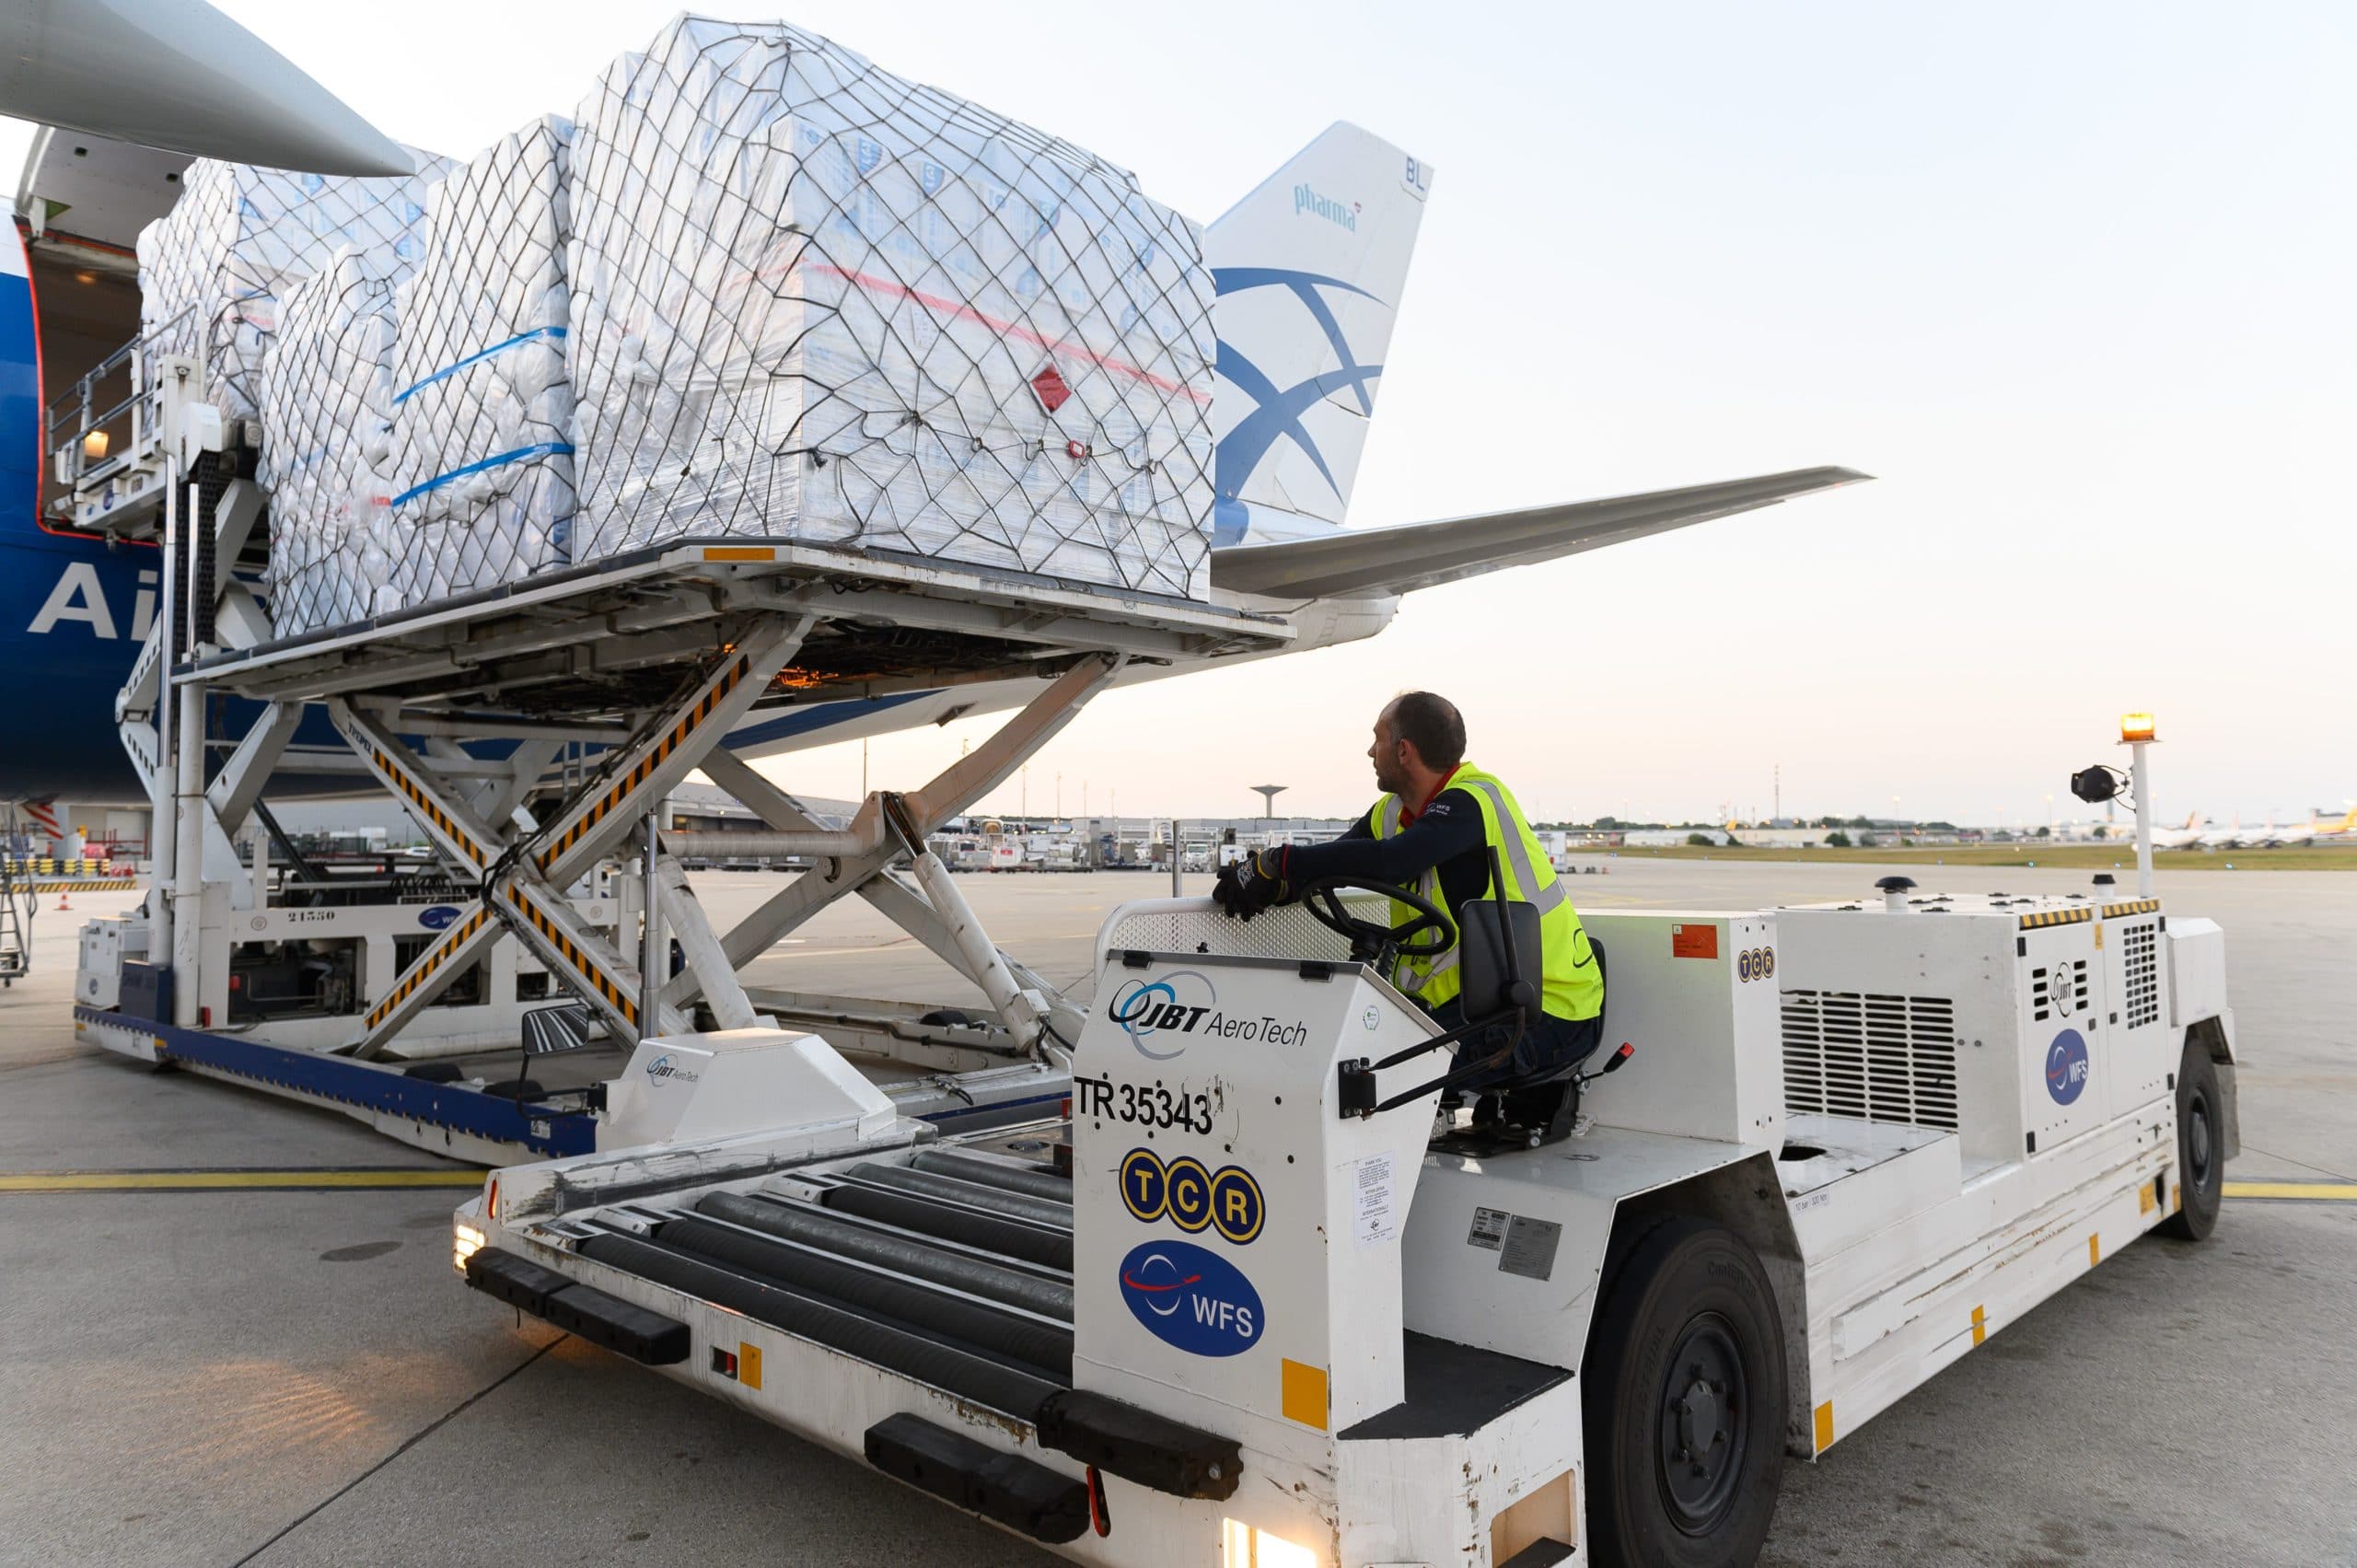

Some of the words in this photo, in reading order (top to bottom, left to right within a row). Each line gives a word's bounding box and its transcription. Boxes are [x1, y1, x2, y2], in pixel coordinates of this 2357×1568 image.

[1407, 155, 1425, 192] BL
[1295, 182, 1356, 233] pharma
[1742, 956, 1772, 974] TCR
[2060, 982, 2072, 1001] JBT
[1138, 1003, 1212, 1033] JBT
[654, 1065, 676, 1077] JBT
[2069, 1059, 2088, 1084] WFS
[1134, 1168, 1248, 1225] TCR
[1192, 1294, 1253, 1338] WFS
